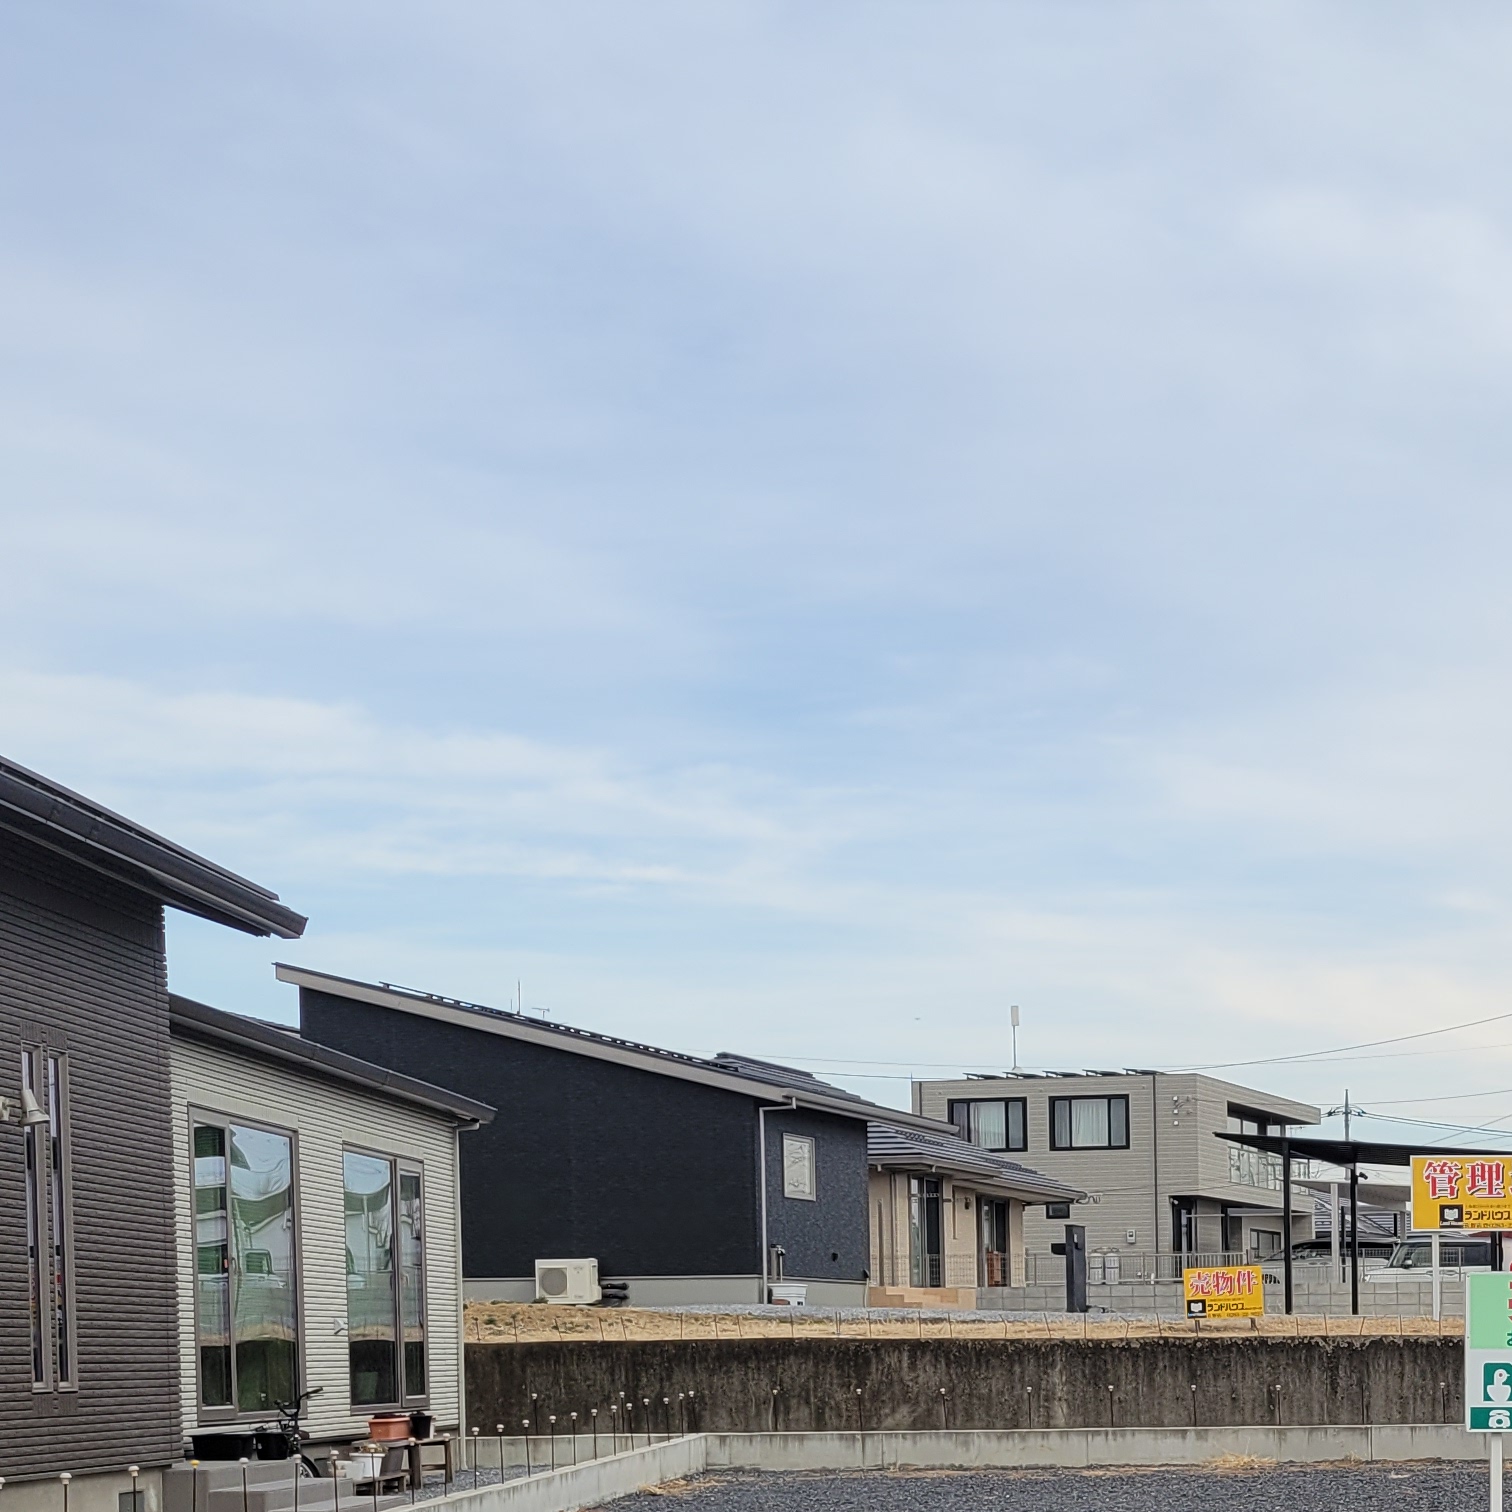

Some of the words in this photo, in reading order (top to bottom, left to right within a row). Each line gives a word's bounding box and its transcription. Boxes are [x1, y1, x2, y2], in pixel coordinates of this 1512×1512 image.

[1465, 1210, 1511, 1220] ランドハウス
[1189, 1269, 1259, 1297] 売物件
[1207, 1302, 1245, 1312] ランドハウス
